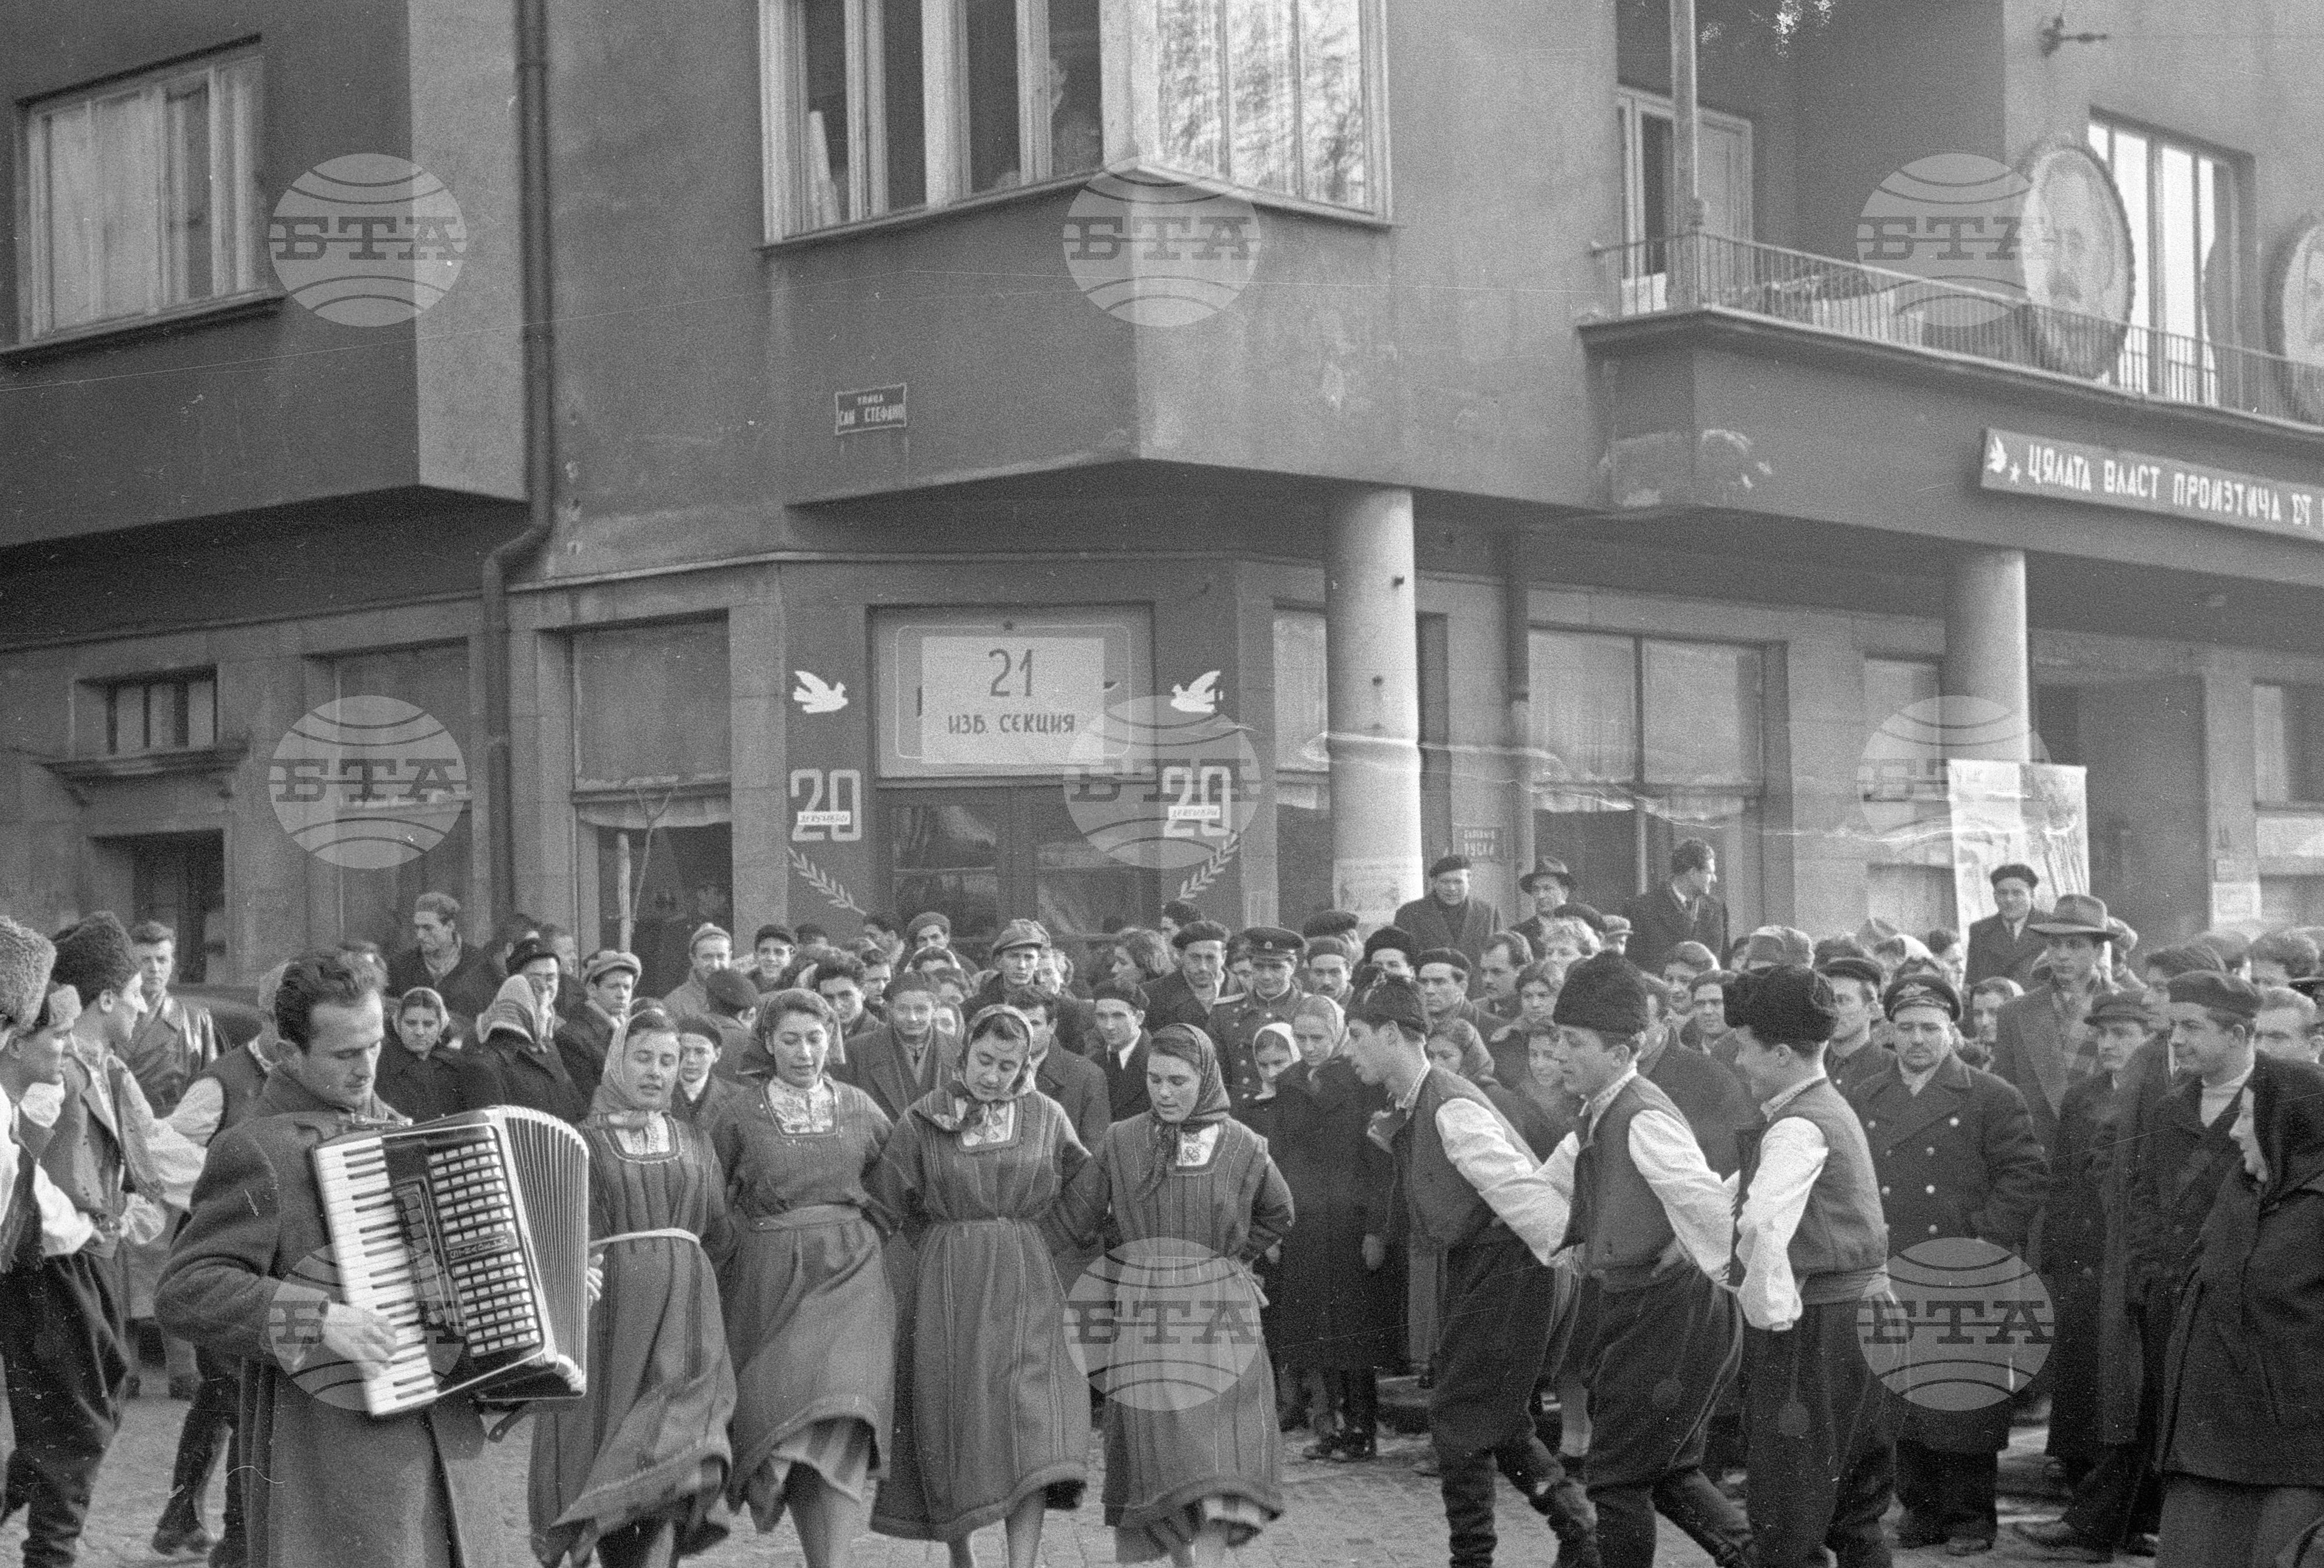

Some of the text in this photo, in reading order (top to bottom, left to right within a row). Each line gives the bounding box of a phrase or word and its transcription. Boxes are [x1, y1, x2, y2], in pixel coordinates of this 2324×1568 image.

[2028, 444, 2091, 492] ЦЯЛАТА
[2104, 459, 2160, 499] ВЛАСТ
[2173, 472, 2281, 522] ПРОИЗТИЧА
[989, 648, 1032, 697] 21
[948, 713, 1075, 735] ИЗБ. СЕКЦИЯ
[790, 769, 861, 841] 20
[1162, 766, 1231, 837] 20
